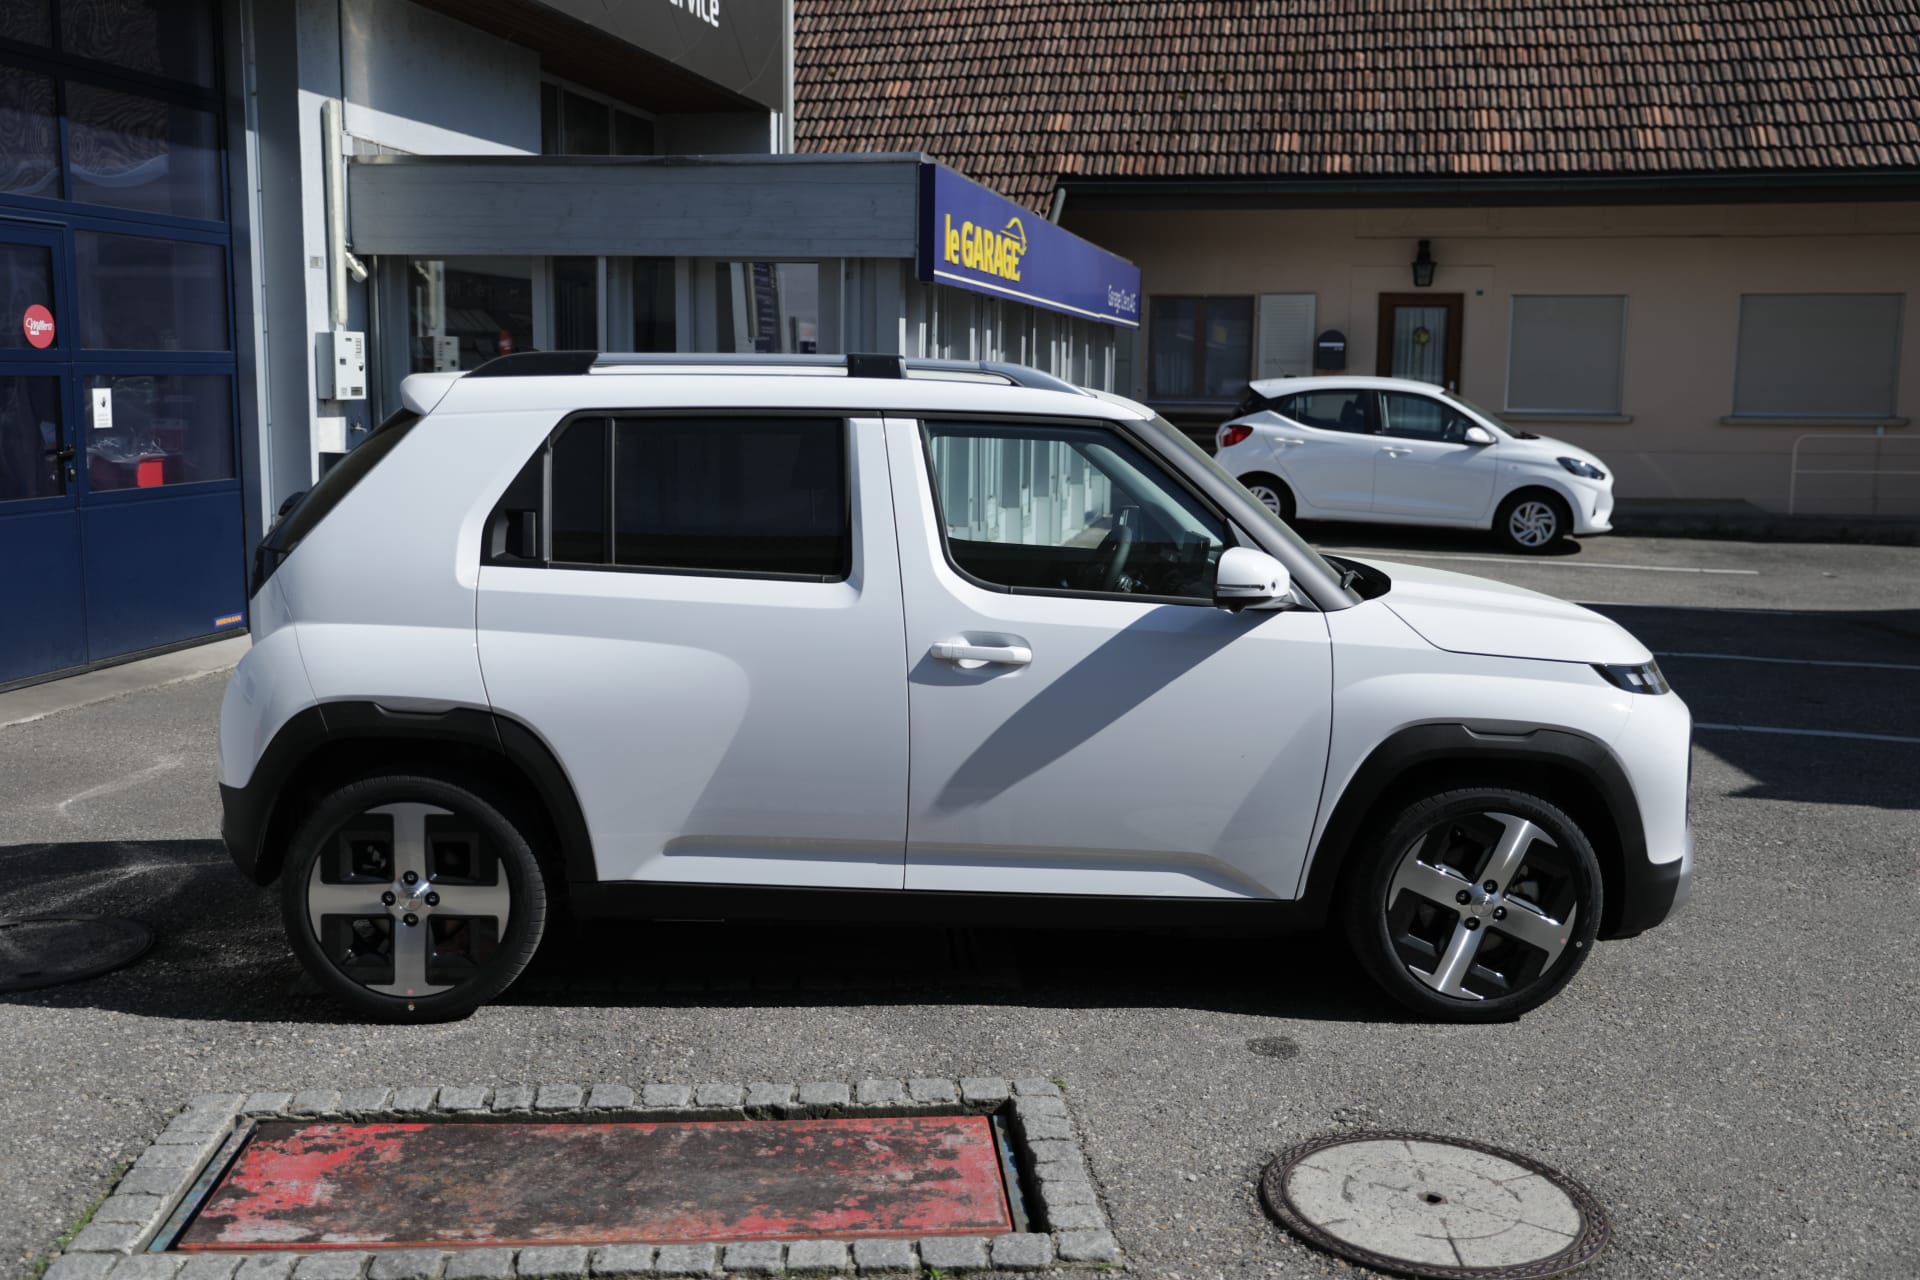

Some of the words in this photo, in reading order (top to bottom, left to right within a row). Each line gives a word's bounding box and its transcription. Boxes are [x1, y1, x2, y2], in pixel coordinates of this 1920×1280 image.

[669, 0, 720, 28] vice
[944, 213, 960, 265] le
[961, 220, 1021, 282] GARAGE
